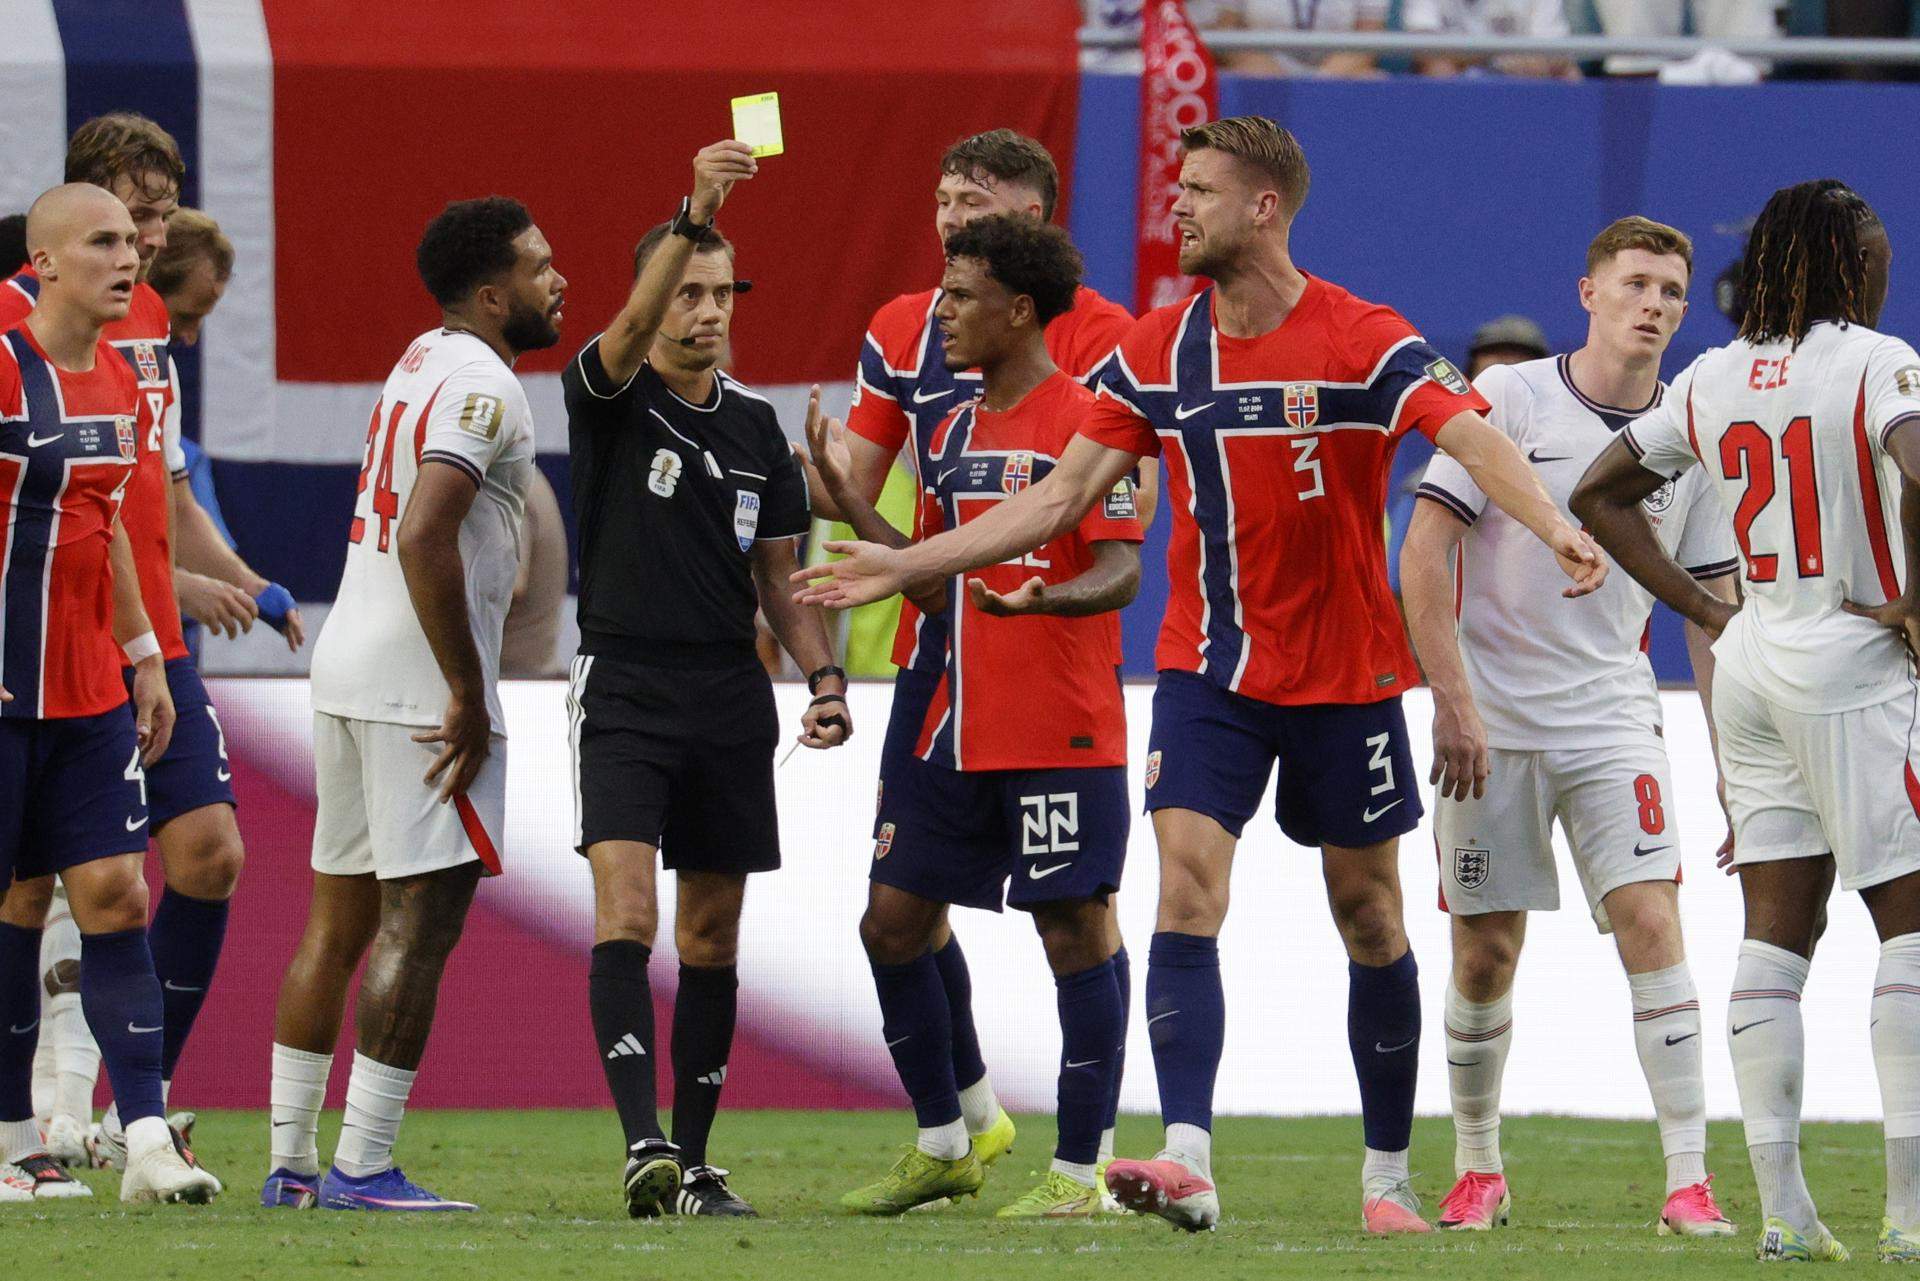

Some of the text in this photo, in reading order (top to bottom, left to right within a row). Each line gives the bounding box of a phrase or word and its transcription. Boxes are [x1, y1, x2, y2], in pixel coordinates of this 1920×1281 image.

[1748, 354, 1791, 390] EZE
[350, 394, 408, 553] 24
[1290, 436, 1325, 501] 3
[1719, 415, 1824, 583] 21
[740, 495, 759, 511] FIFA
[124, 745, 147, 806] 4
[1366, 732, 1395, 796] 3
[1020, 792, 1080, 855] 22
[1633, 774, 1665, 835] 8
